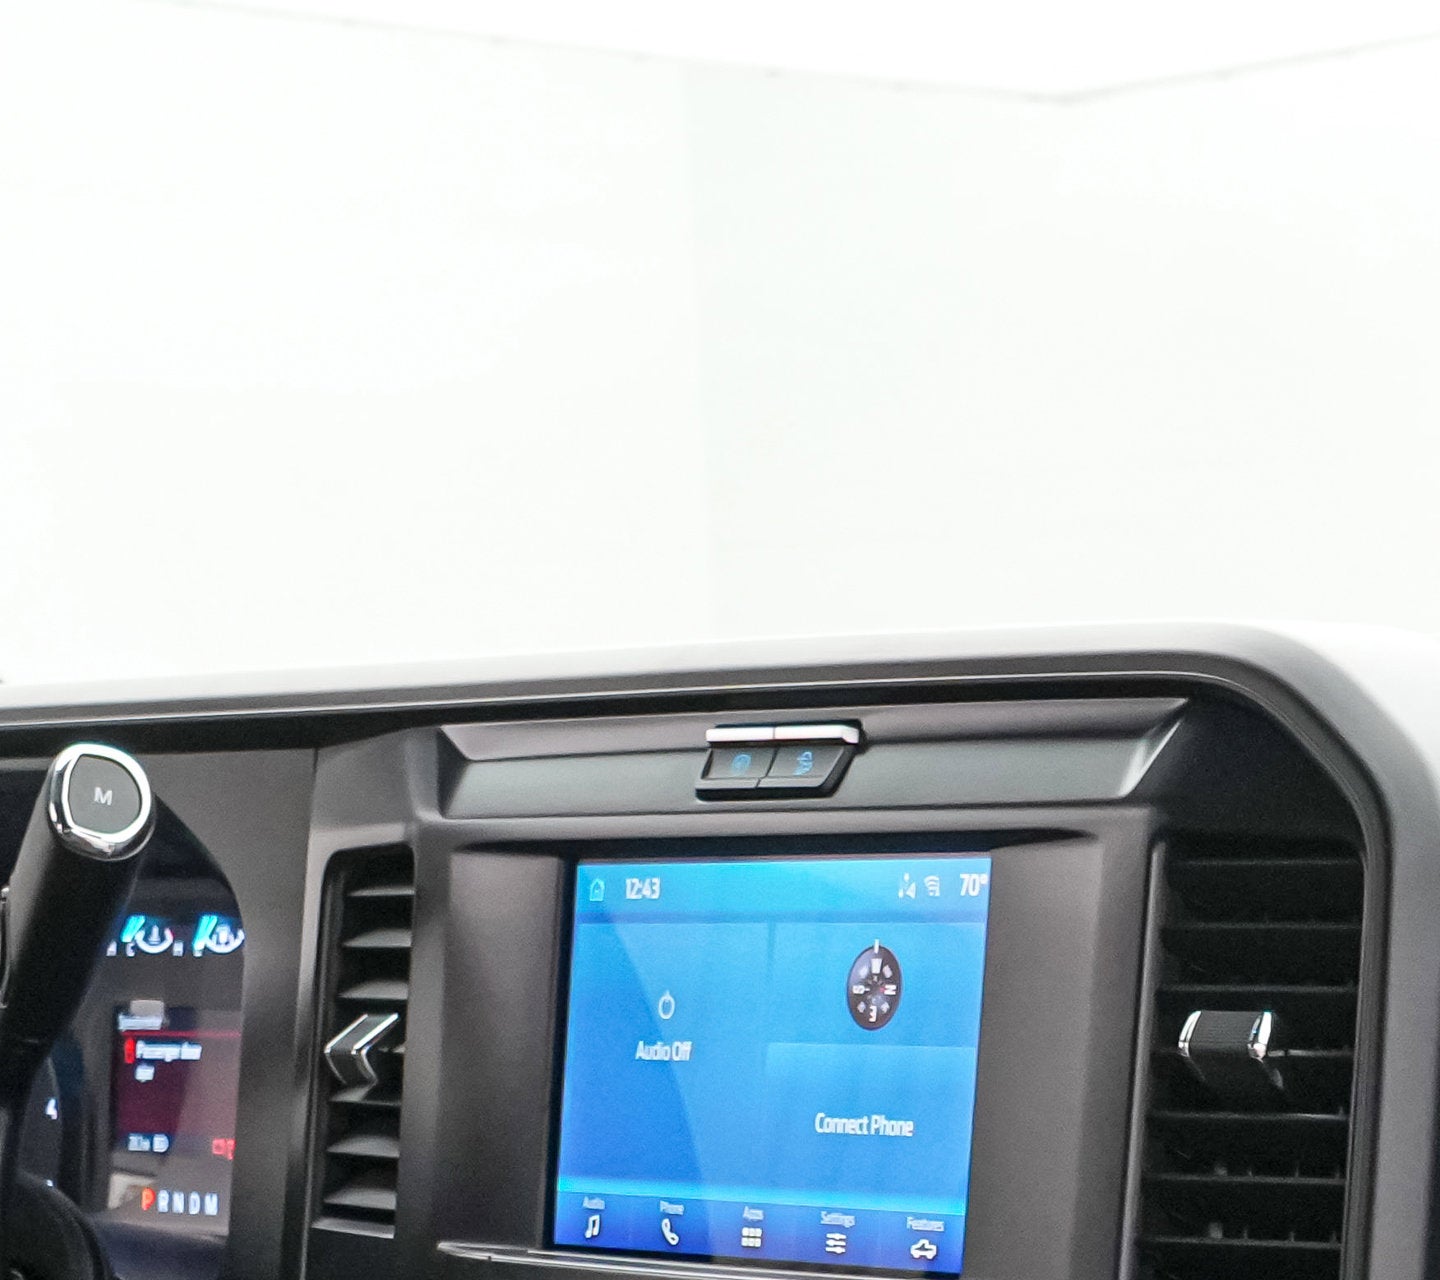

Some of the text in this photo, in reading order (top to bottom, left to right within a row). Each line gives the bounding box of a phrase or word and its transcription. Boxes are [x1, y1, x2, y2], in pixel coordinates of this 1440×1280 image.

[93, 787, 113, 806] M
[626, 877, 660, 900] 12:43
[960, 873, 988, 896] 70°
[635, 1041, 692, 1061] Audio Off
[815, 1113, 914, 1137] Connect Phone
